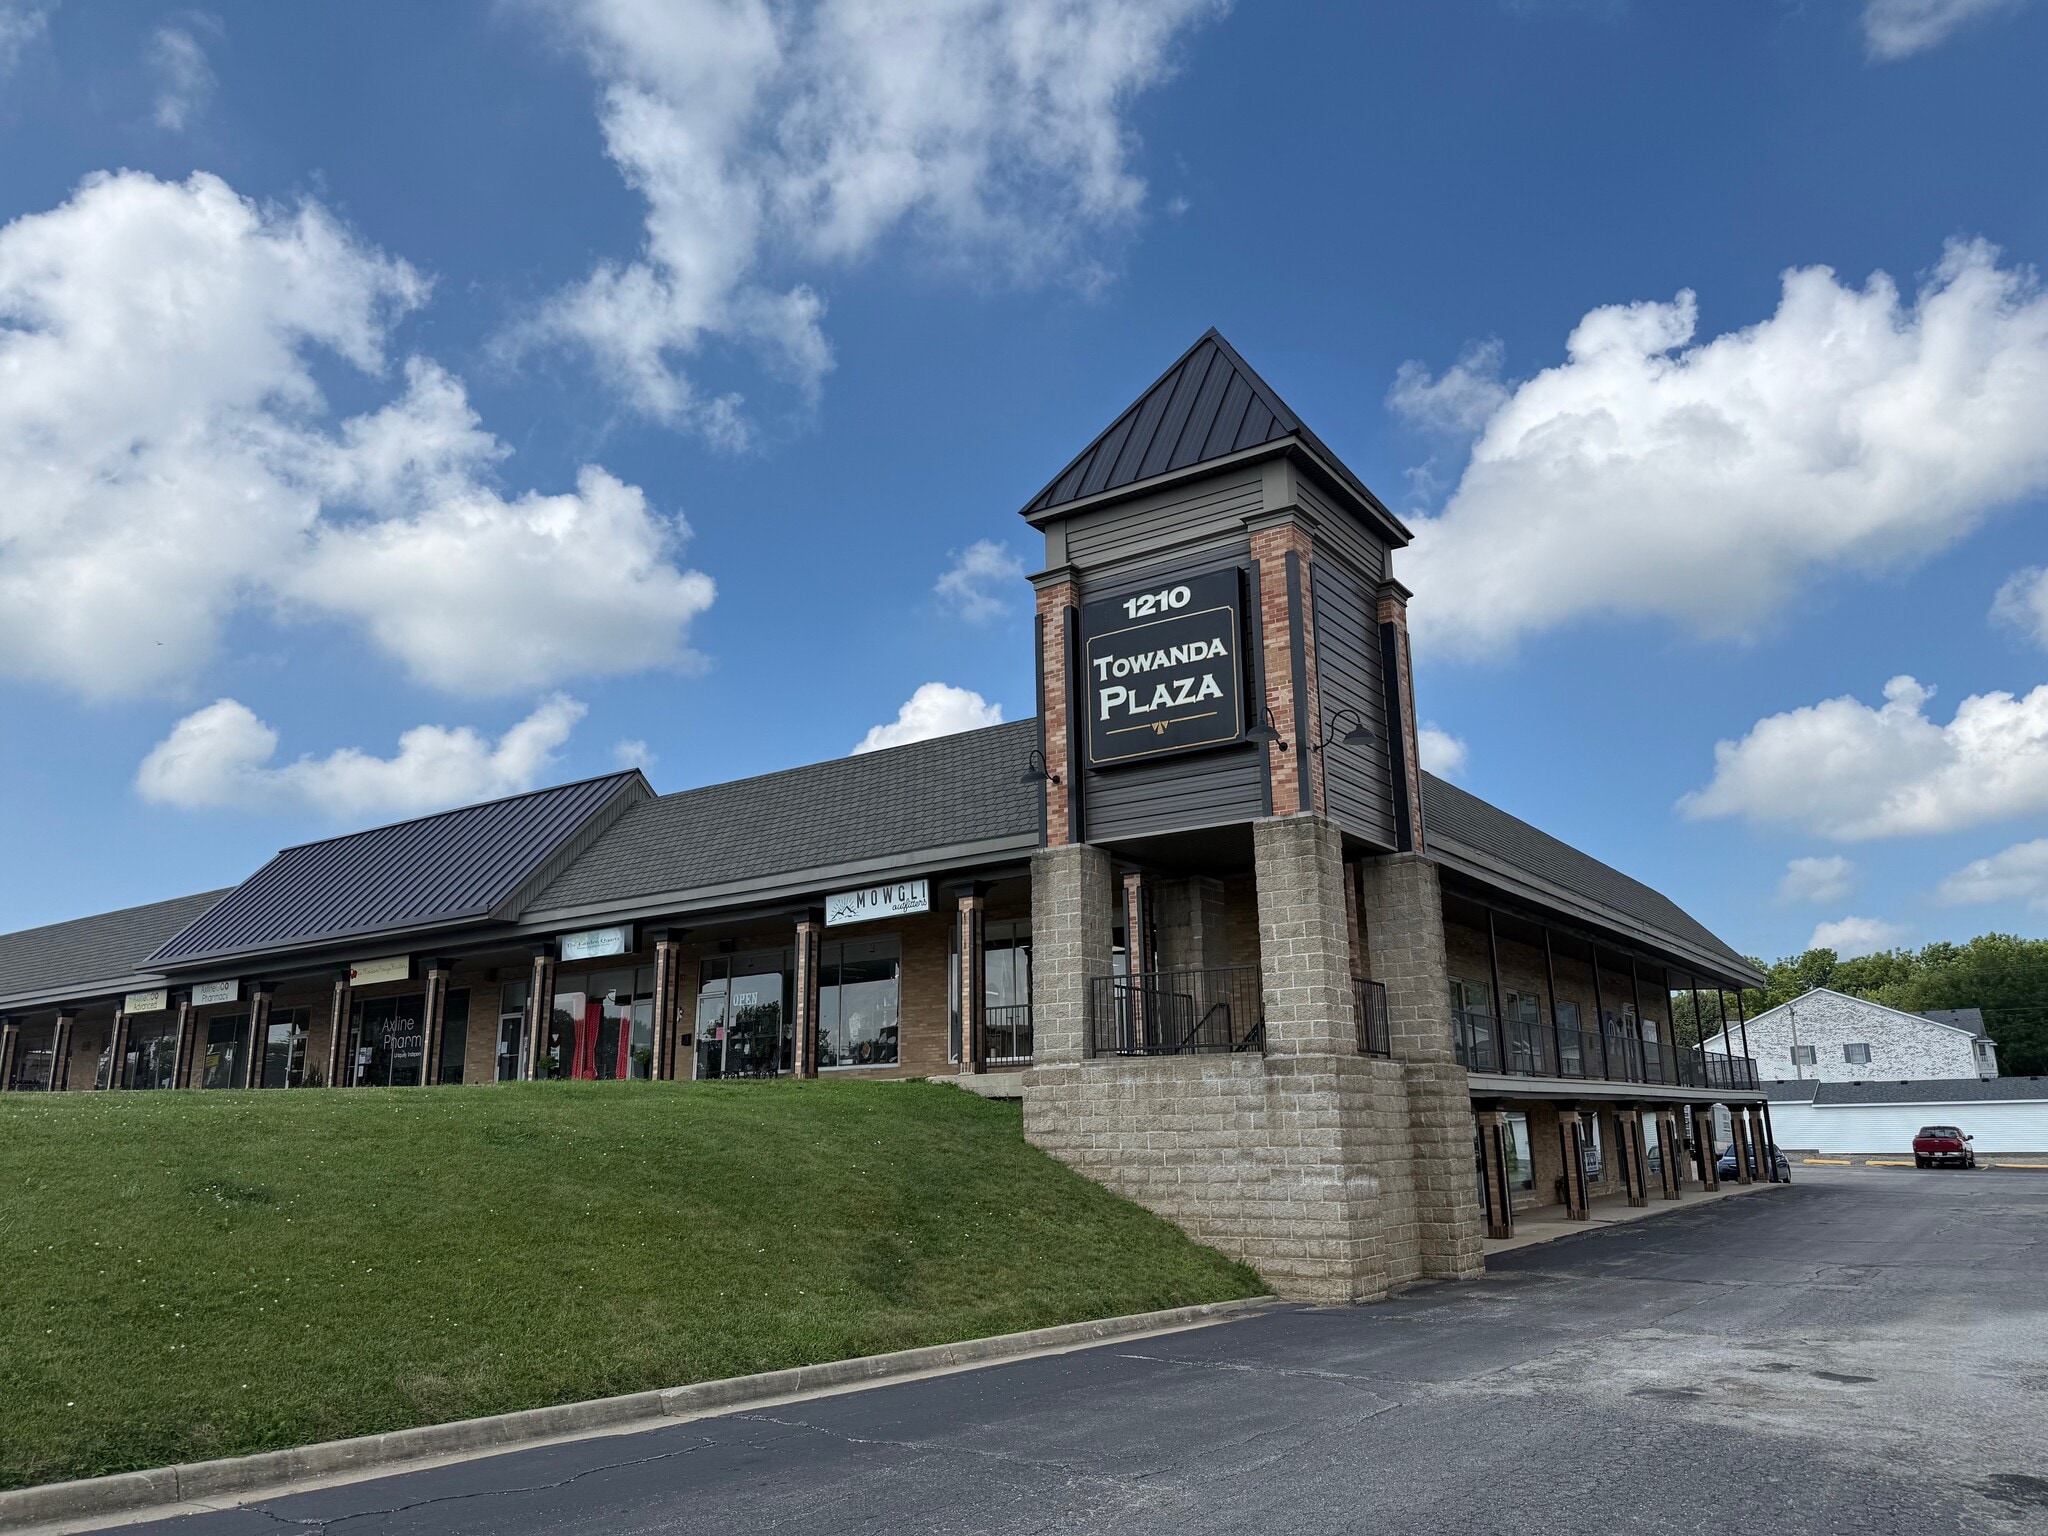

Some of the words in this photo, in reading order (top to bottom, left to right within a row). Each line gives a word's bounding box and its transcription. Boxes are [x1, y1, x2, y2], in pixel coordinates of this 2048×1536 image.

[1123, 585, 1191, 619] 1210
[856, 881, 926, 909] MOWGLI
[133, 1001, 158, 1010] Advanced
[202, 993, 229, 1003] Pharmacy
[733, 992, 758, 1006] OPEN
[382, 1016, 415, 1033] Axline
[383, 1034, 422, 1050] Pharm
